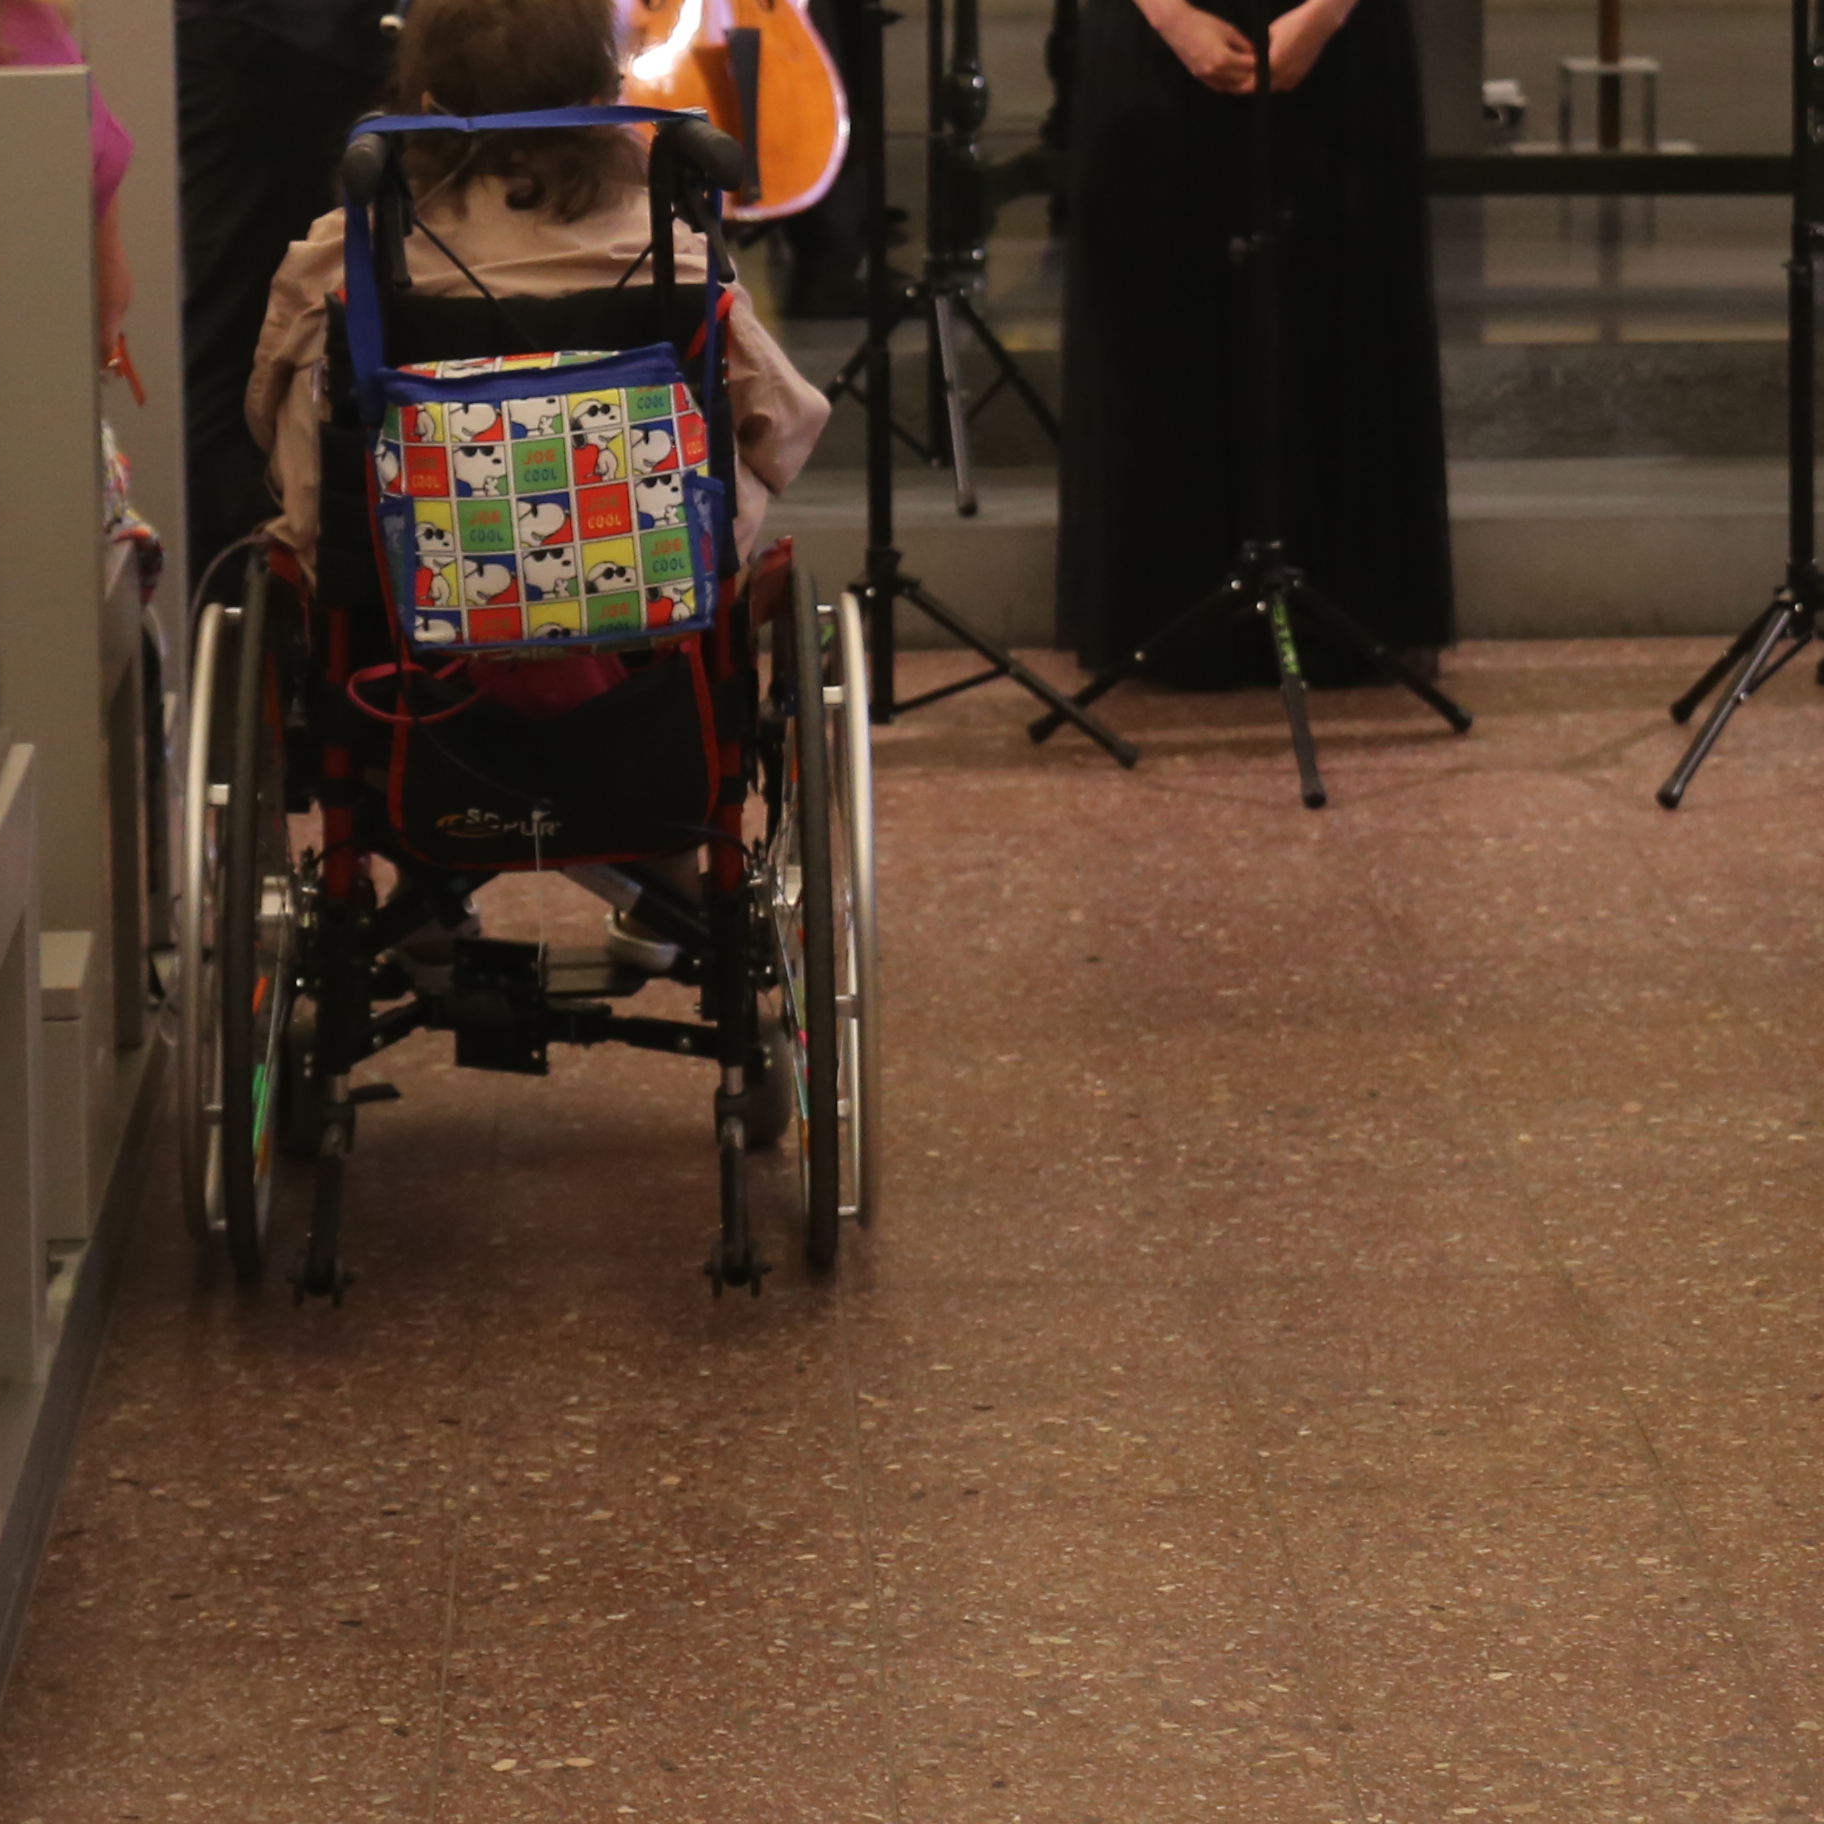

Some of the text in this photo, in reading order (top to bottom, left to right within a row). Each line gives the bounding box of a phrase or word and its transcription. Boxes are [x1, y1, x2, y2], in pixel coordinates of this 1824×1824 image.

[522, 448, 557, 466] JOE
[523, 468, 558, 483] COOL
[469, 510, 502, 525] JOE
[587, 514, 622, 530] COOL
[469, 529, 504, 543] COOL
[651, 537, 683, 556] JOE
[652, 557, 686, 574] COOL
[598, 601, 631, 620] JOE
